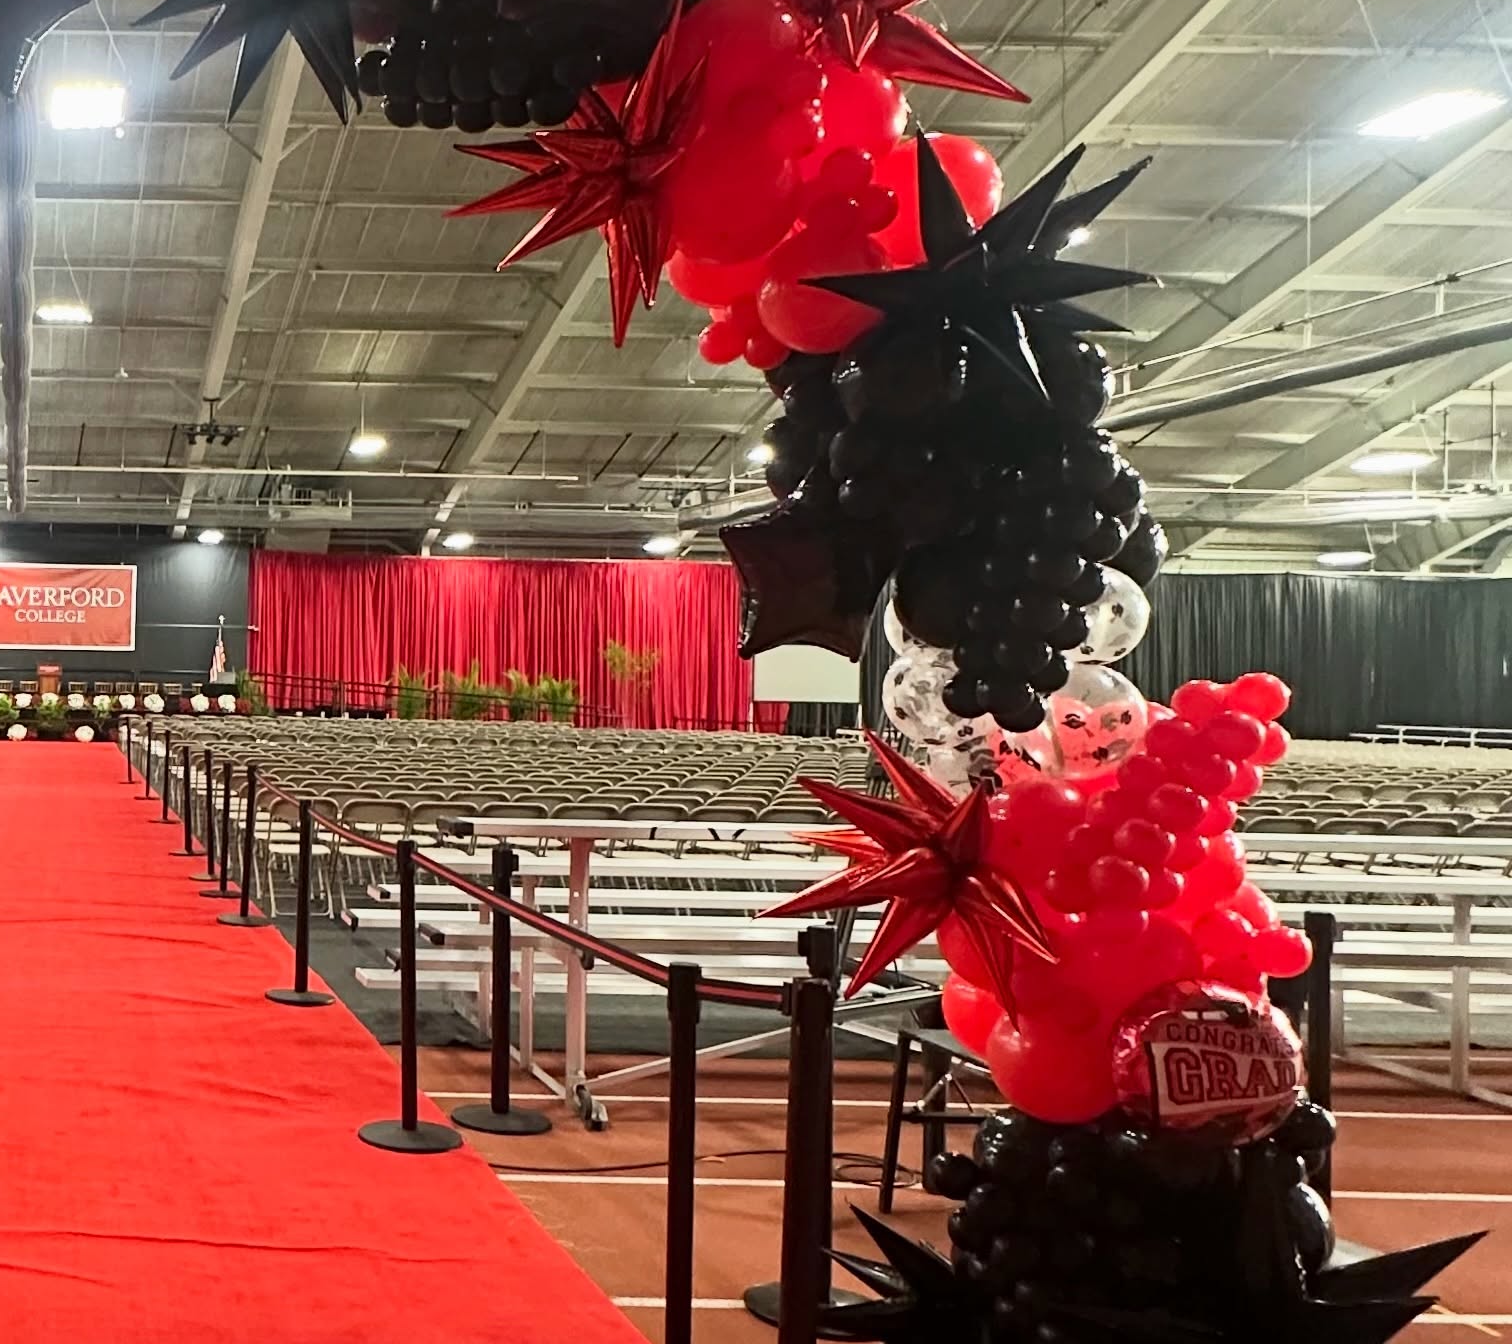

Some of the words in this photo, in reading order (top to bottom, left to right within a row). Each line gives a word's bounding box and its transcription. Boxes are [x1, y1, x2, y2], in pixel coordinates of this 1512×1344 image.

[13, 607, 87, 624] COLLEGE
[1165, 1023, 1297, 1058] CONGRATS
[1163, 1045, 1297, 1106] GRAD
